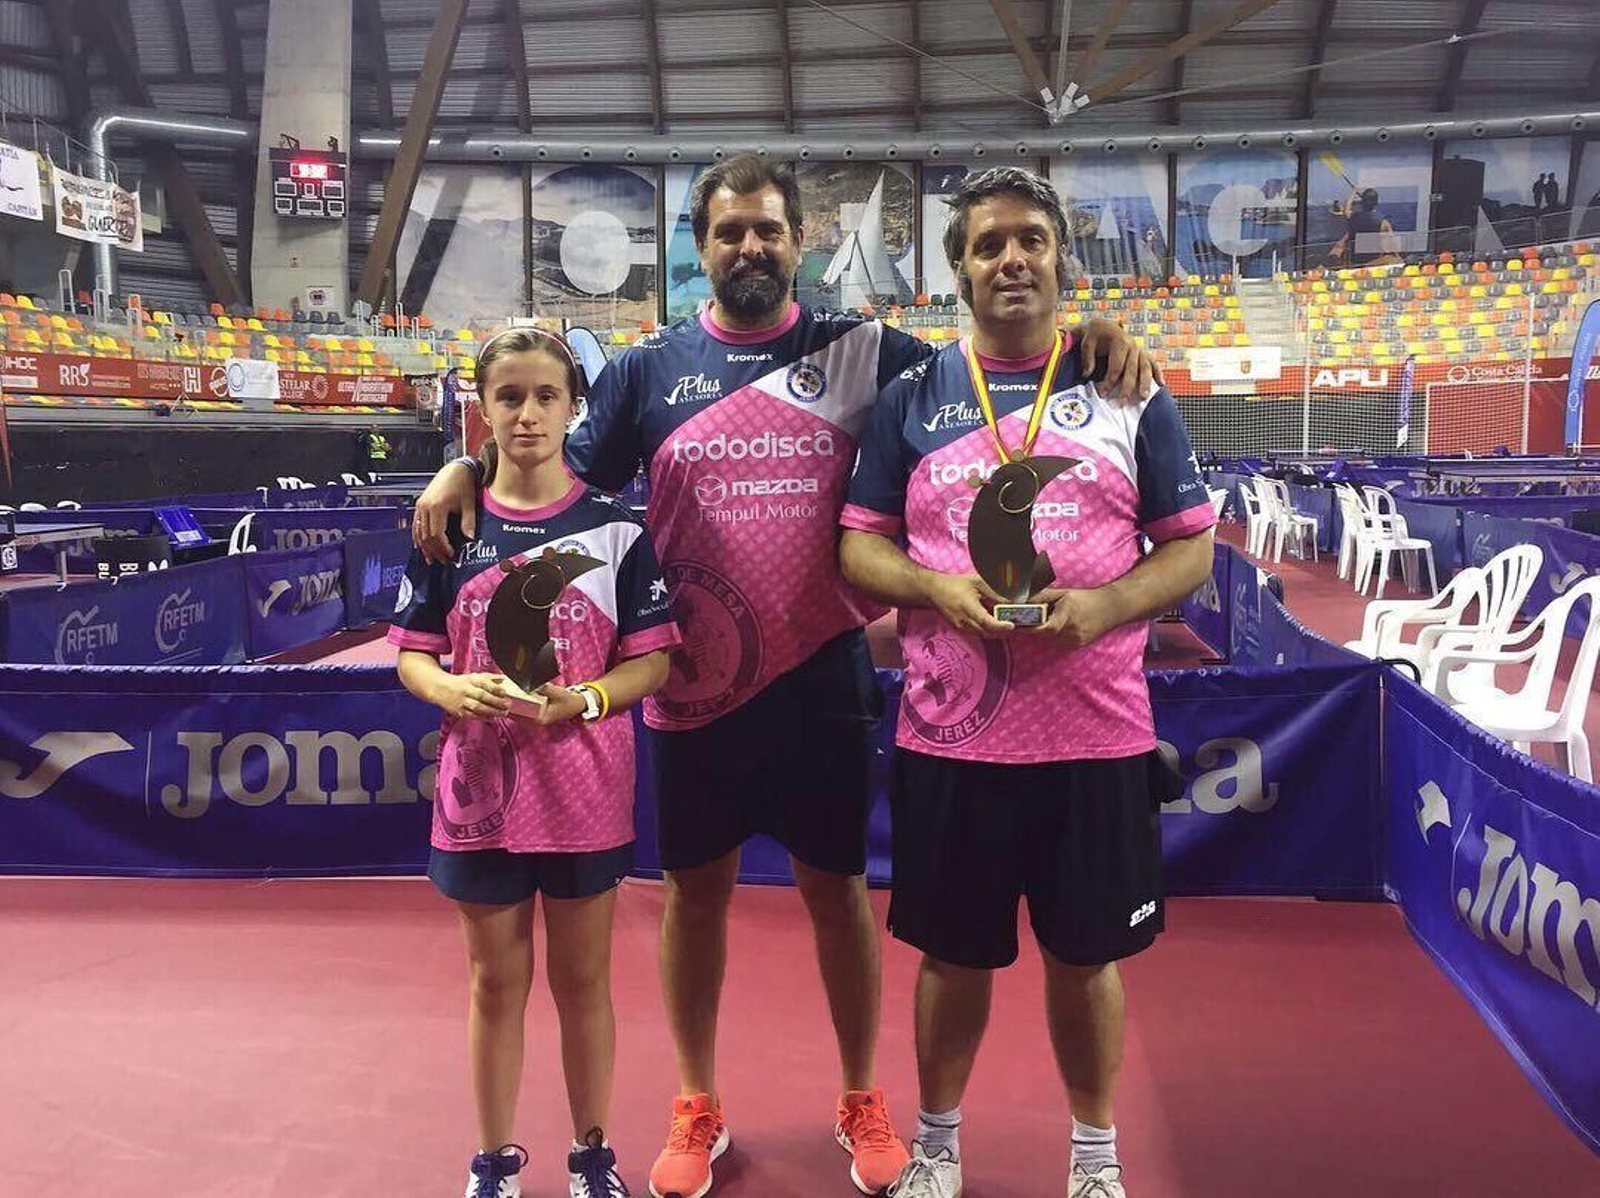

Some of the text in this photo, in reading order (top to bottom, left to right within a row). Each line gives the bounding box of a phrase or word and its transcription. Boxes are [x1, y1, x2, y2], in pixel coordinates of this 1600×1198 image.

[726, 353, 773, 362] Kromex
[680, 373, 721, 397] Plus
[989, 382, 1038, 392] Kromex
[938, 401, 980, 424] Plus
[502, 524, 546, 534] Kromex
[66, 622, 118, 653] RFETM
[934, 710, 985, 742] JEREZ
